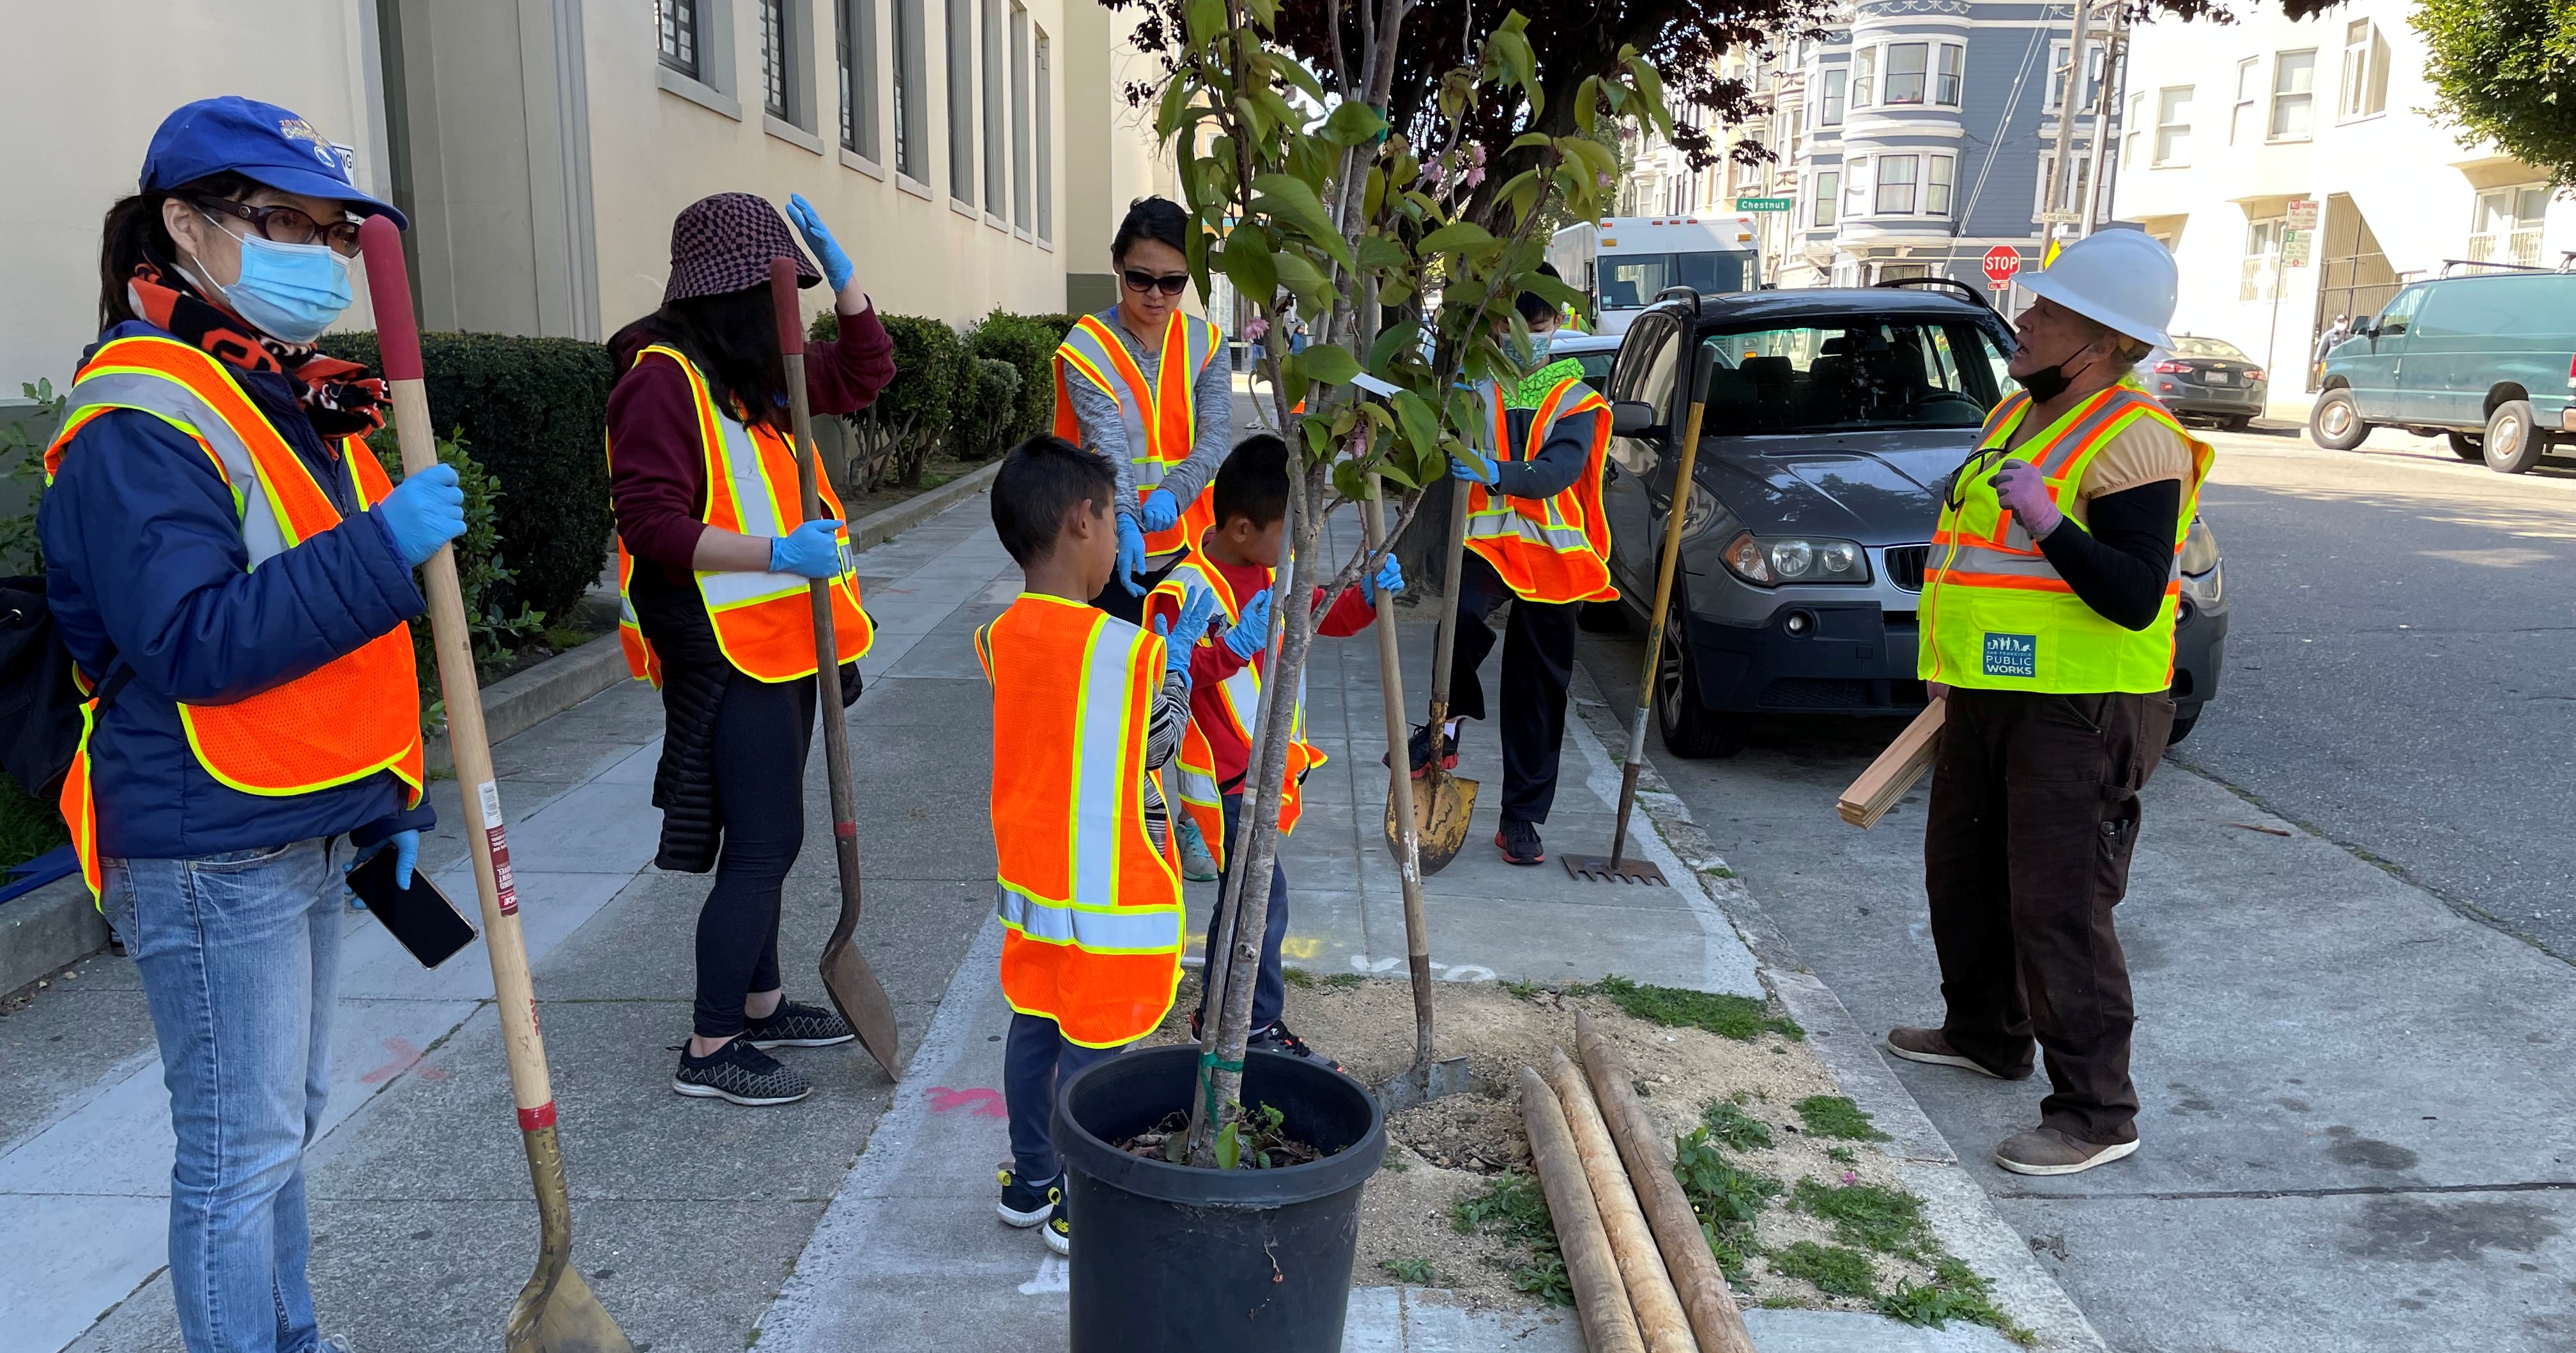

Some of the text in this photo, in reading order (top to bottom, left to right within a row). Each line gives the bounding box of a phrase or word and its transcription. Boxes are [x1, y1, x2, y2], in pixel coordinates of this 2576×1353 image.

[1742, 201, 1785, 209] Chestnut
[1986, 256, 2018, 270] STOP
[1986, 655, 2032, 666] PUBLIC
[1986, 664, 2032, 675] WORKS
